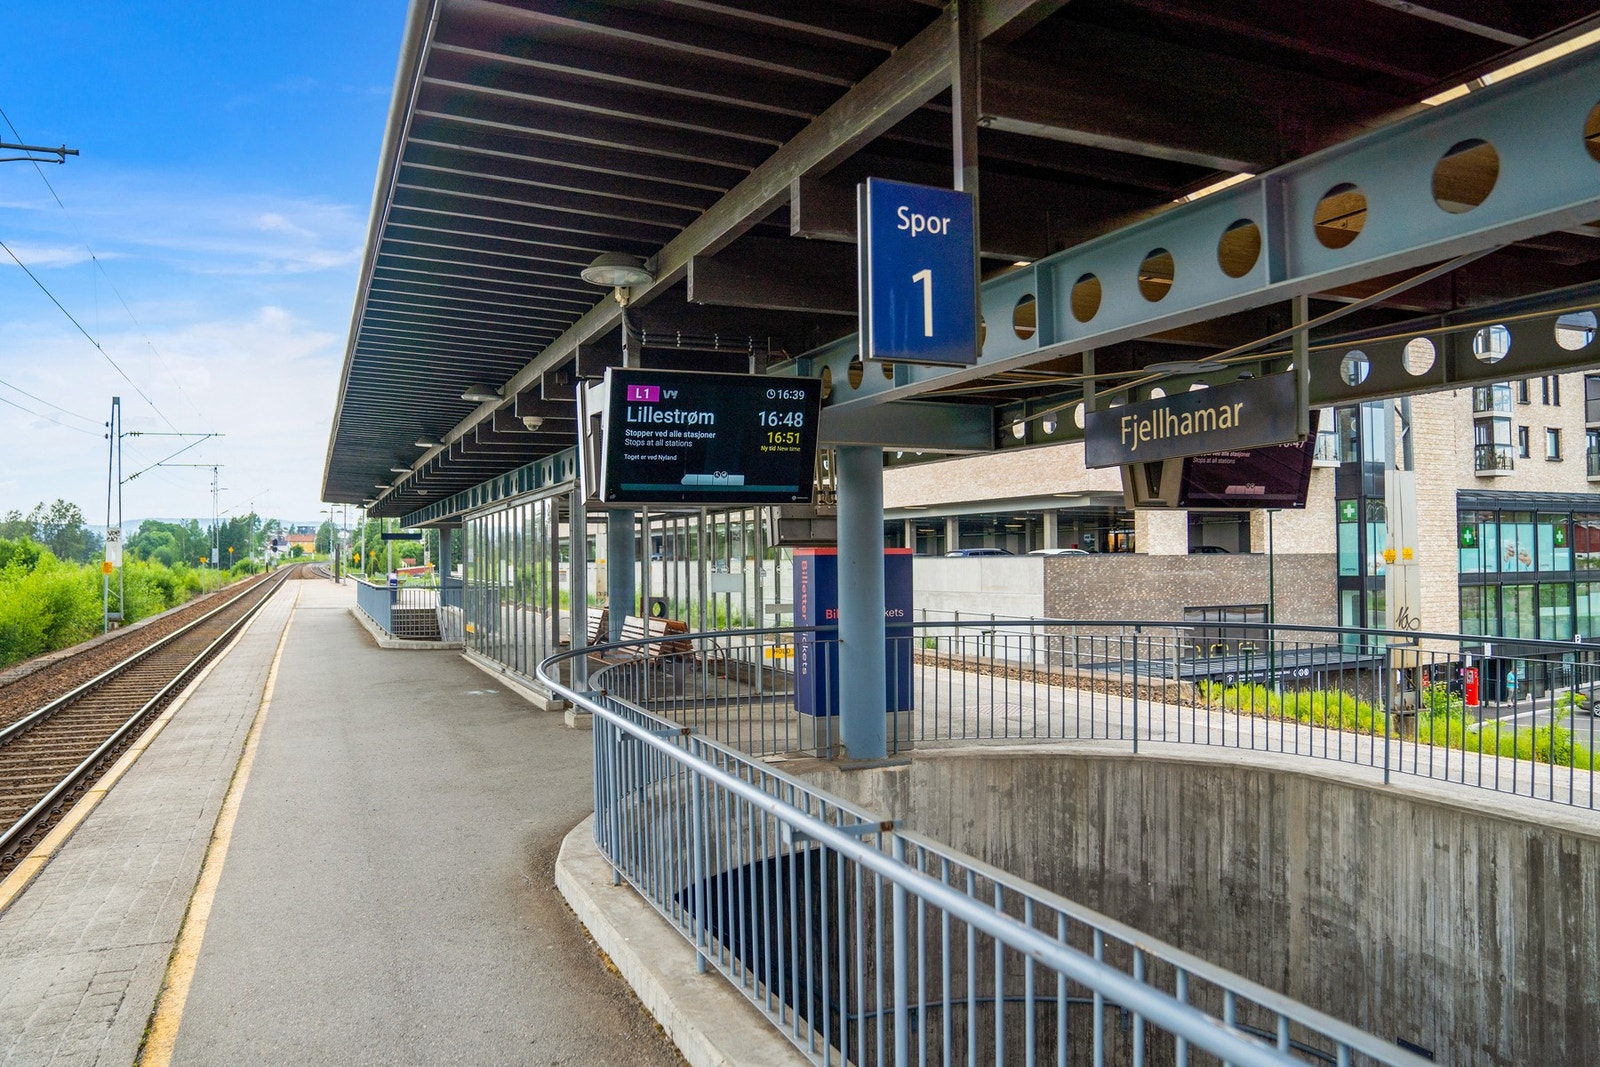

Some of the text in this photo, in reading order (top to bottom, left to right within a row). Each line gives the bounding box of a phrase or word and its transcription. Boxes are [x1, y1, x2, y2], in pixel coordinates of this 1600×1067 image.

[897, 205, 950, 237] Spor
[912, 269, 933, 337] 1
[635, 387, 650, 399] L1
[777, 389, 805, 400] 16:39
[626, 406, 715, 425] Lillestrøm
[758, 410, 803, 427] 16:48
[625, 428, 716, 439] Stopper ved alle stasjoner
[1121, 402, 1244, 452] Fjellhamar
[624, 438, 646, 447] Stops
[767, 431, 800, 444] 16:51
[884, 608, 904, 617] kets
